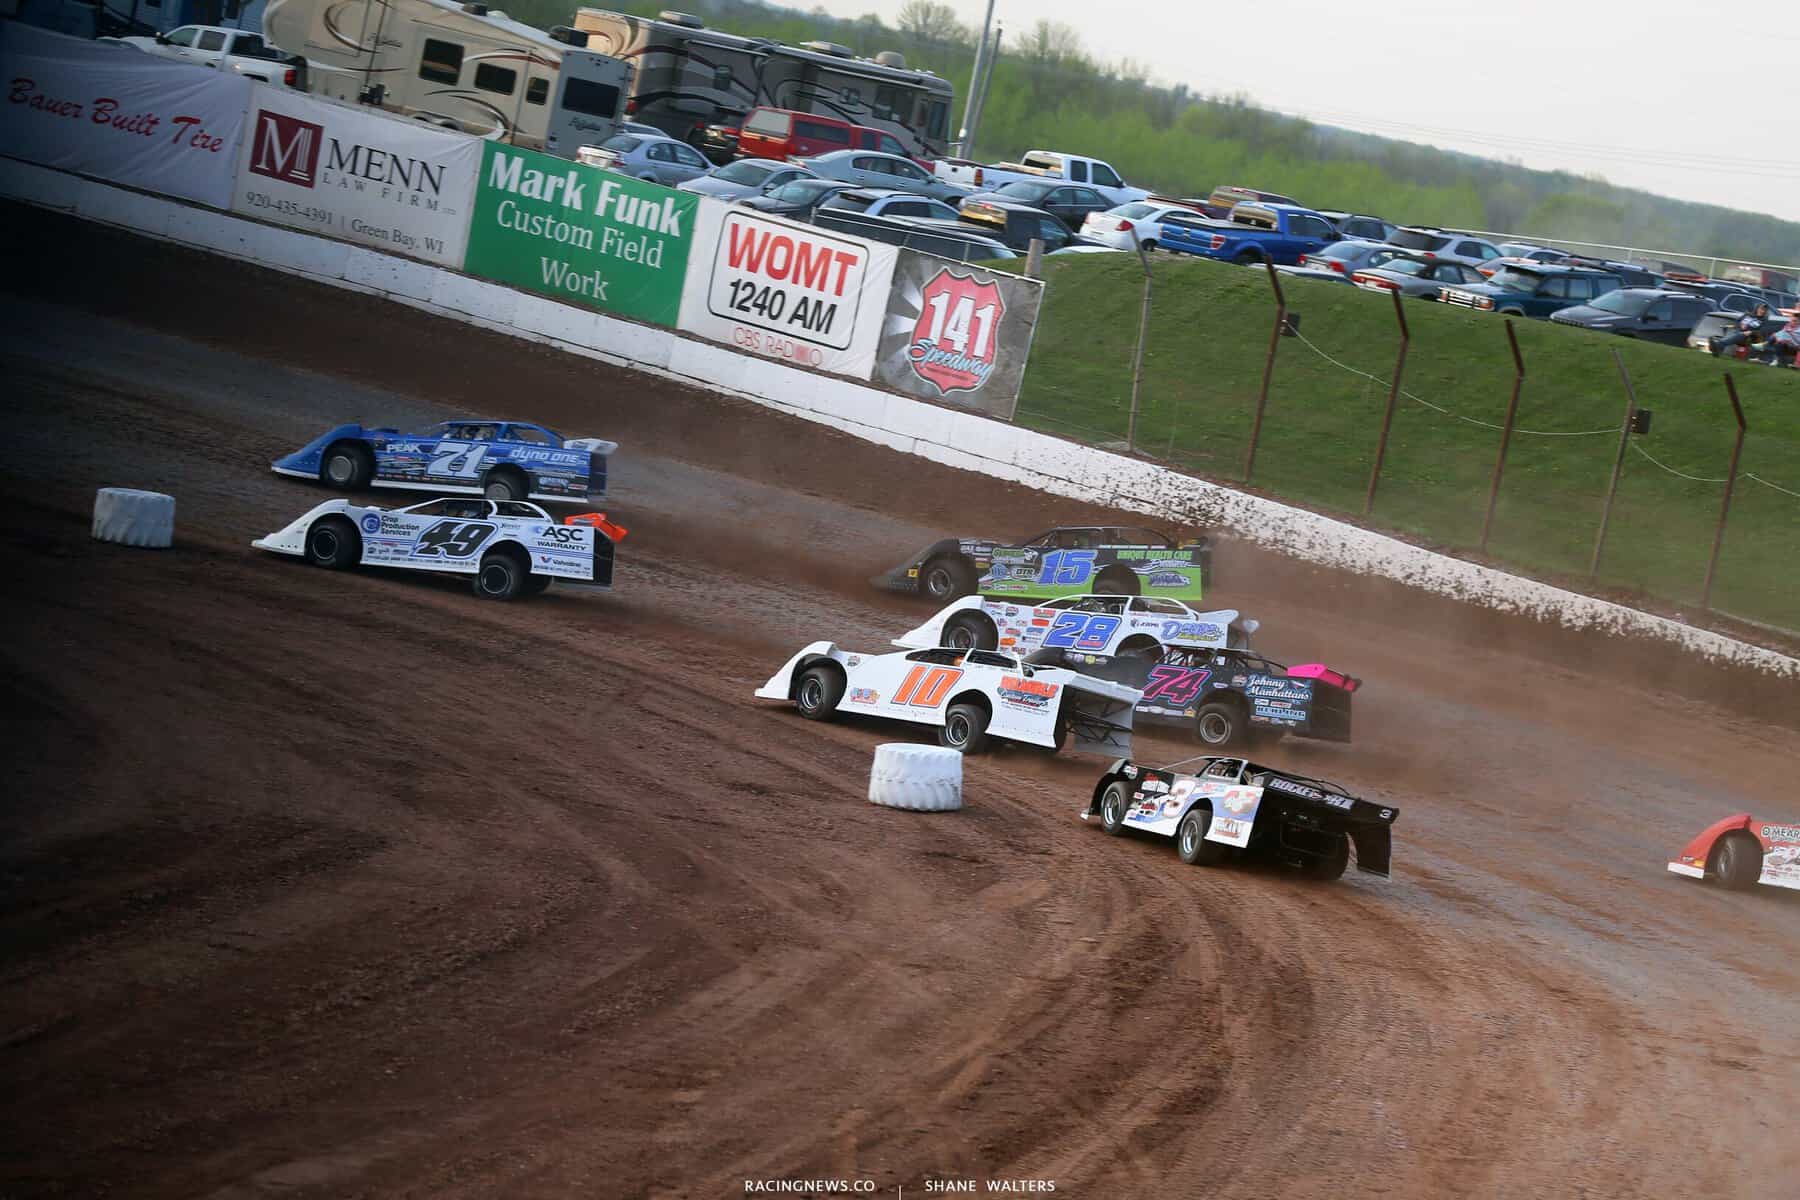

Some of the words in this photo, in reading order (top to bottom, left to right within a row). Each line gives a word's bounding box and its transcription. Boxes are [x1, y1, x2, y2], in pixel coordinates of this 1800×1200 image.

[8, 77, 83, 118] Bauer
[92, 97, 160, 136] Built
[172, 116, 224, 152] Tire
[325, 138, 447, 196] MENN
[322, 172, 367, 192] LAW
[382, 188, 440, 211] FIRM
[489, 152, 587, 211] Mark
[595, 180, 683, 237] Funk
[247, 191, 333, 225] 920-435-4391
[351, 218, 388, 240] Green
[425, 236, 445, 254] WI
[497, 200, 593, 250] Custom
[600, 227, 664, 269] Field
[541, 256, 609, 301] Work
[728, 222, 858, 296] WOMT
[729, 278, 786, 321] 1240
[787, 296, 837, 335] AM
[930, 291, 995, 358] 141
[734, 327, 761, 349] CBS
[910, 338, 993, 378] Speedway
[386, 443, 422, 454] PEAK
[428, 441, 488, 478] 71
[415, 521, 496, 558] 49
[537, 541, 587, 551] WARRANTY
[542, 526, 584, 543] ASC
[1039, 549, 1098, 585] 15
[1042, 612, 1122, 651] 28
[891, 664, 964, 708] 10
[1142, 666, 1211, 705] 74
[1249, 674, 1286, 689] Johnny
[1250, 686, 1309, 700] Manhattans
